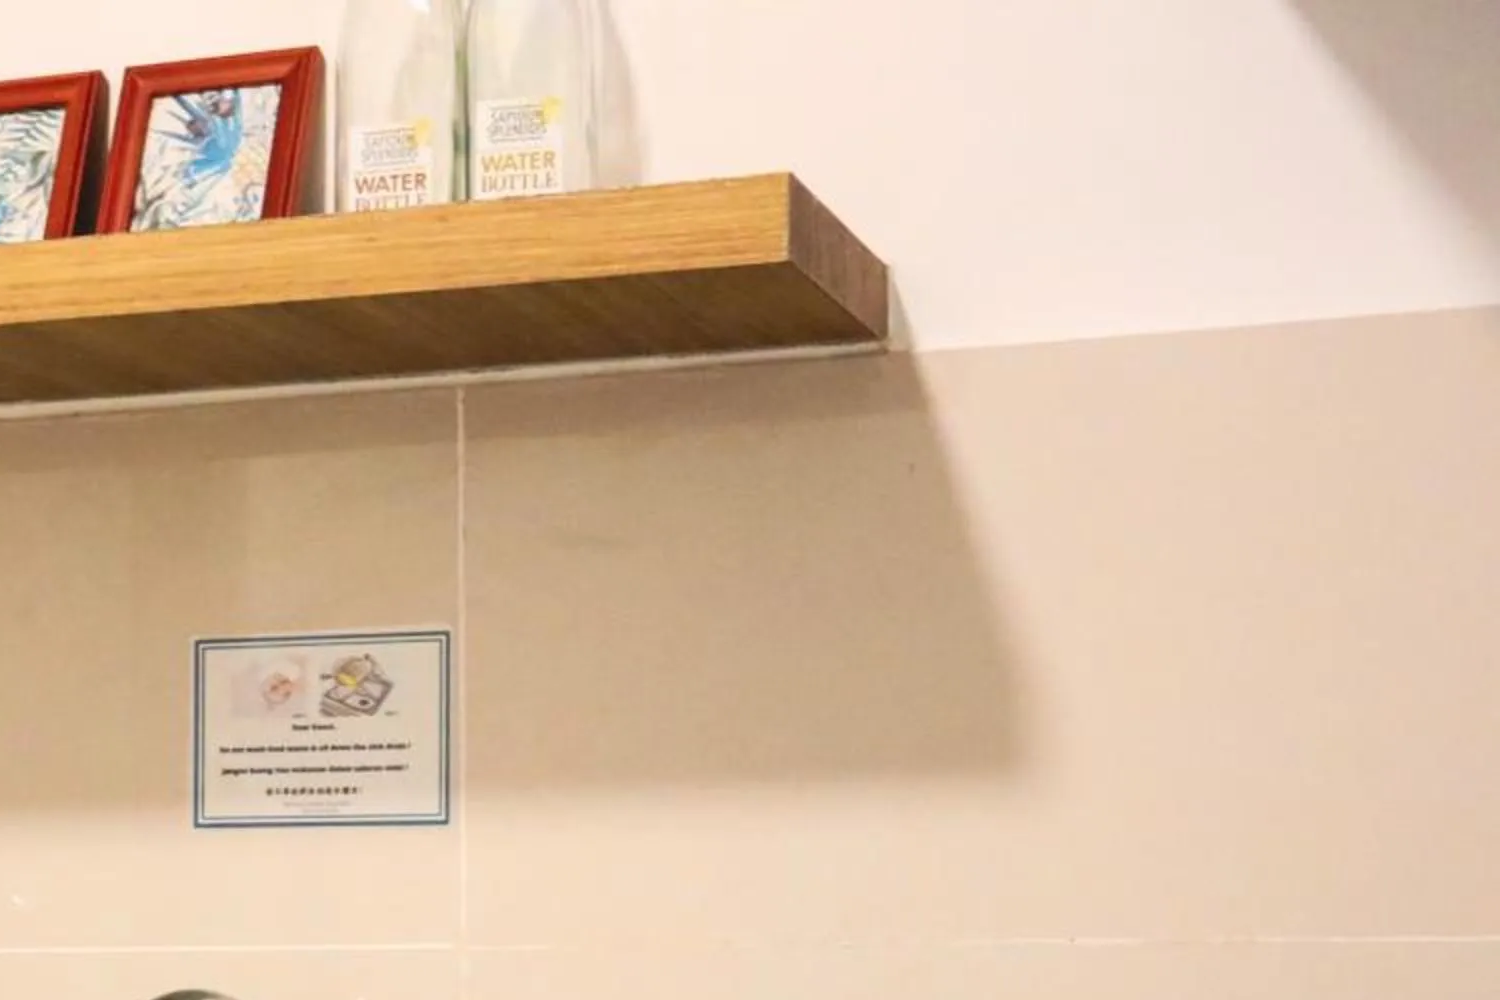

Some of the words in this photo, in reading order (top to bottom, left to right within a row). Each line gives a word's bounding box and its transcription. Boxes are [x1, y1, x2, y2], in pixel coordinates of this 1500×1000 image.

[481, 151, 556, 173] WATER
[354, 172, 427, 194] WATER
[481, 171, 559, 193] BOTTLE
